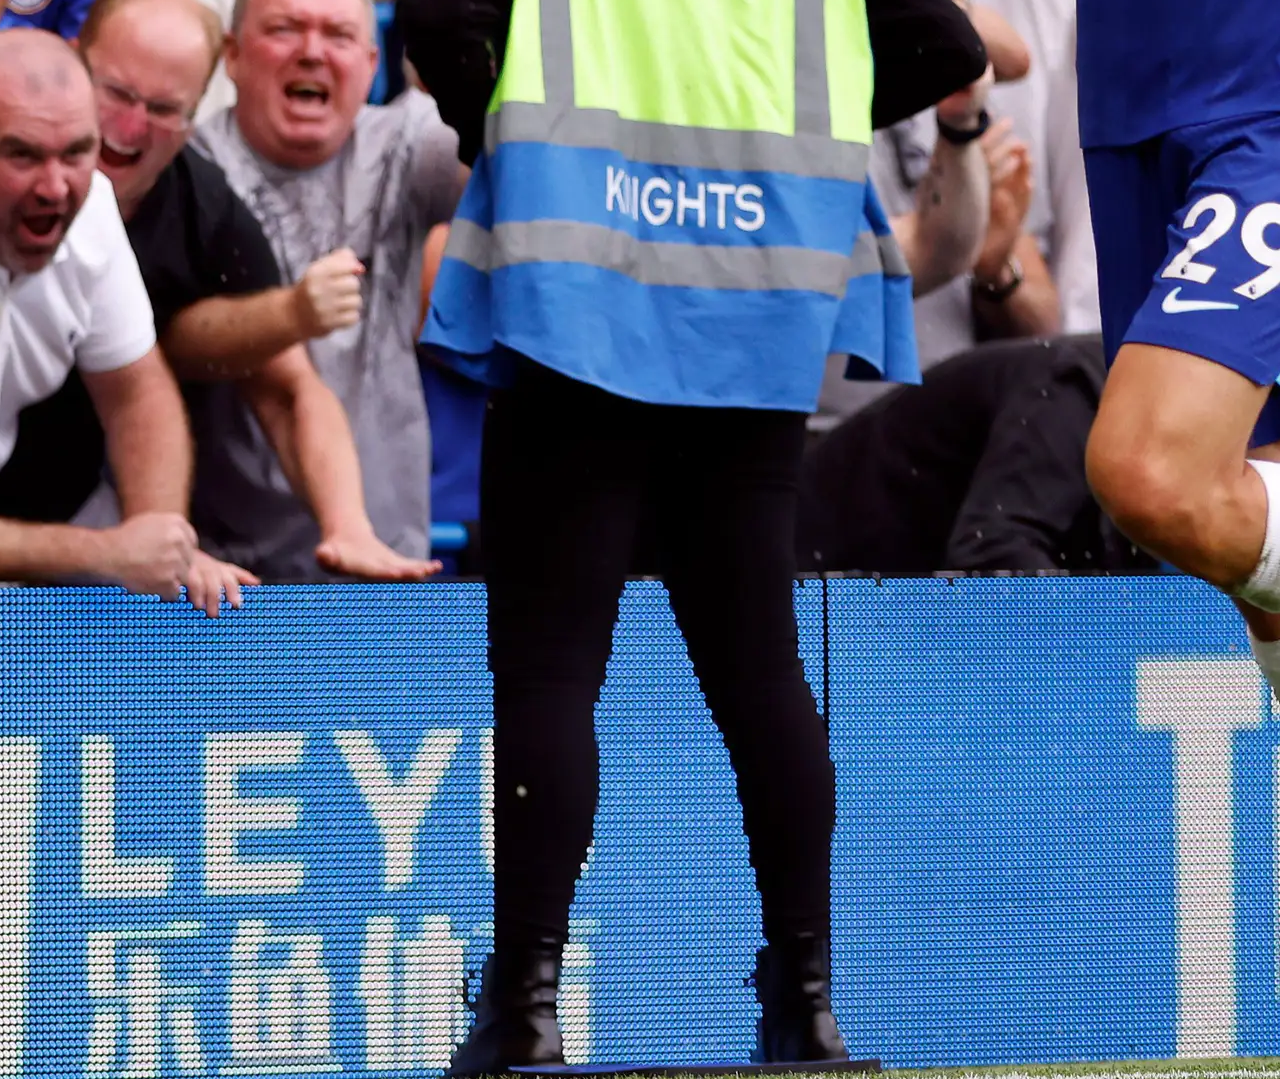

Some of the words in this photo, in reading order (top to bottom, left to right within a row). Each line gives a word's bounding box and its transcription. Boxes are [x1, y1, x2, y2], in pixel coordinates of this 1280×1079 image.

[81, 729, 495, 897] LEY
[86, 915, 598, 1078] 乐鱼体
